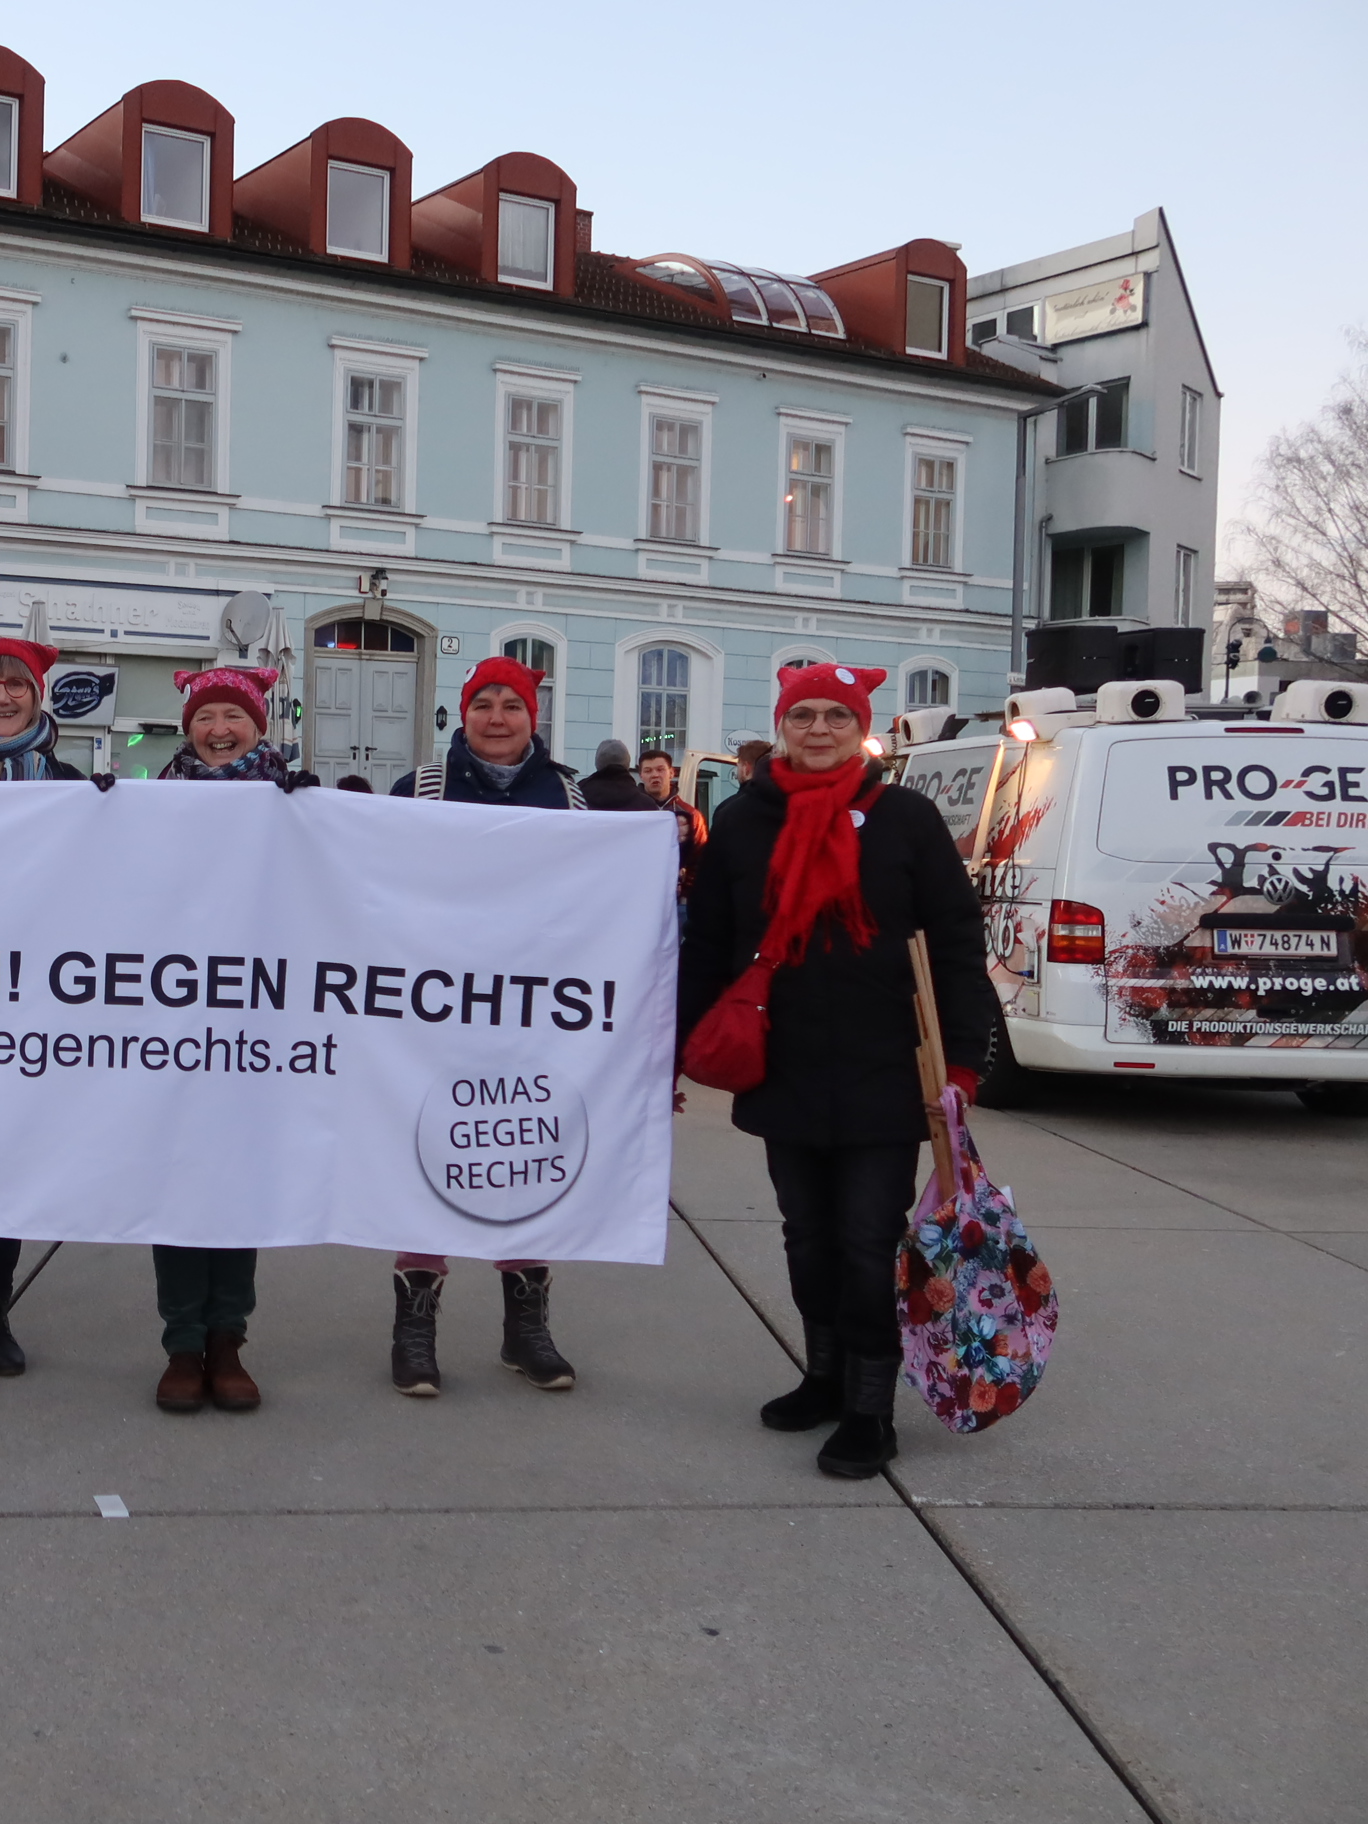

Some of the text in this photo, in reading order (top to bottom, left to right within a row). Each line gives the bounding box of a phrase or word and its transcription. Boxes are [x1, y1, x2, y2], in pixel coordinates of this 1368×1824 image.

[447, 637, 453, 648] 2
[1300, 811, 1331, 828] BEI
[1229, 933, 1242, 950] W
[1257, 933, 1316, 951] 74874
[1320, 935, 1331, 951] N
[48, 951, 288, 1011] GEGEN
[313, 961, 616, 1032] RECHTS!
[1190, 974, 1360, 996] www.proge.at
[1168, 1021, 1189, 1032] DIE
[451, 1074, 552, 1107] OMAS
[449, 1116, 559, 1149] GEGEN
[446, 1155, 566, 1190] RECHTS
